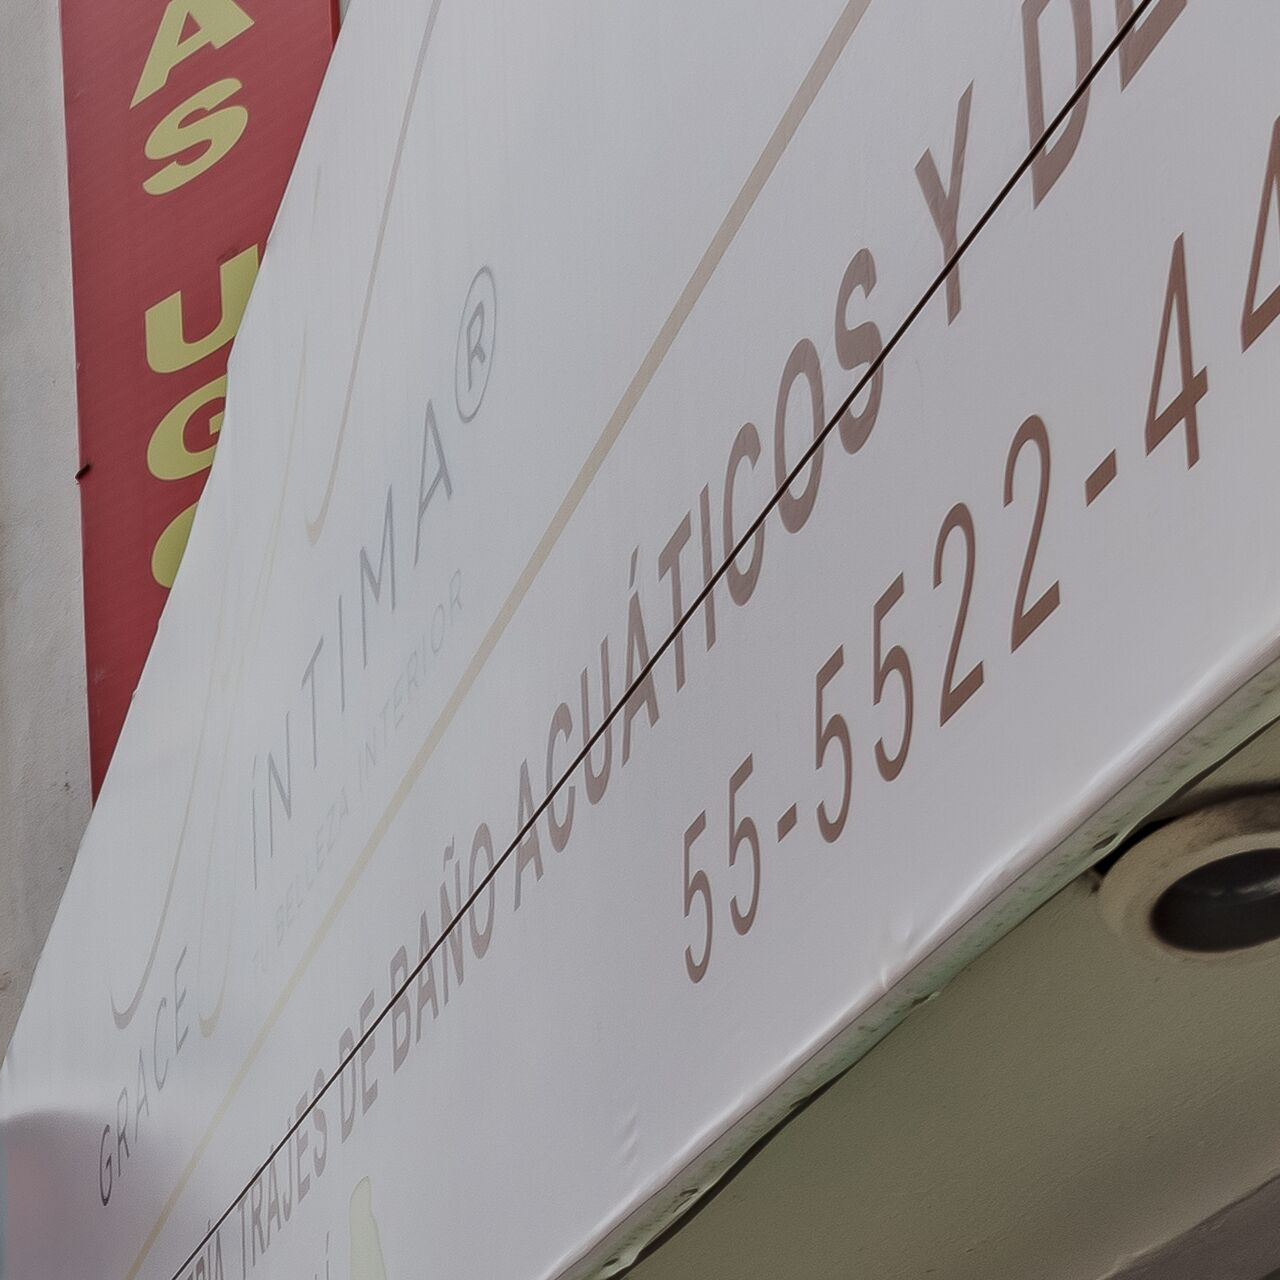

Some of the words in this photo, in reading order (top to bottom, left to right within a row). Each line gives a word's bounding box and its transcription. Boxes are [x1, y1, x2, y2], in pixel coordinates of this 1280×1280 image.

[338, 986, 381, 1145] DE
[389, 821, 498, 1076] BAÑO
[513, 246, 885, 912] ACUÁTICOS
[914, 78, 974, 327] Y
[358, 568, 464, 793] INTERIOR
[98, 944, 189, 1207] GRACE
